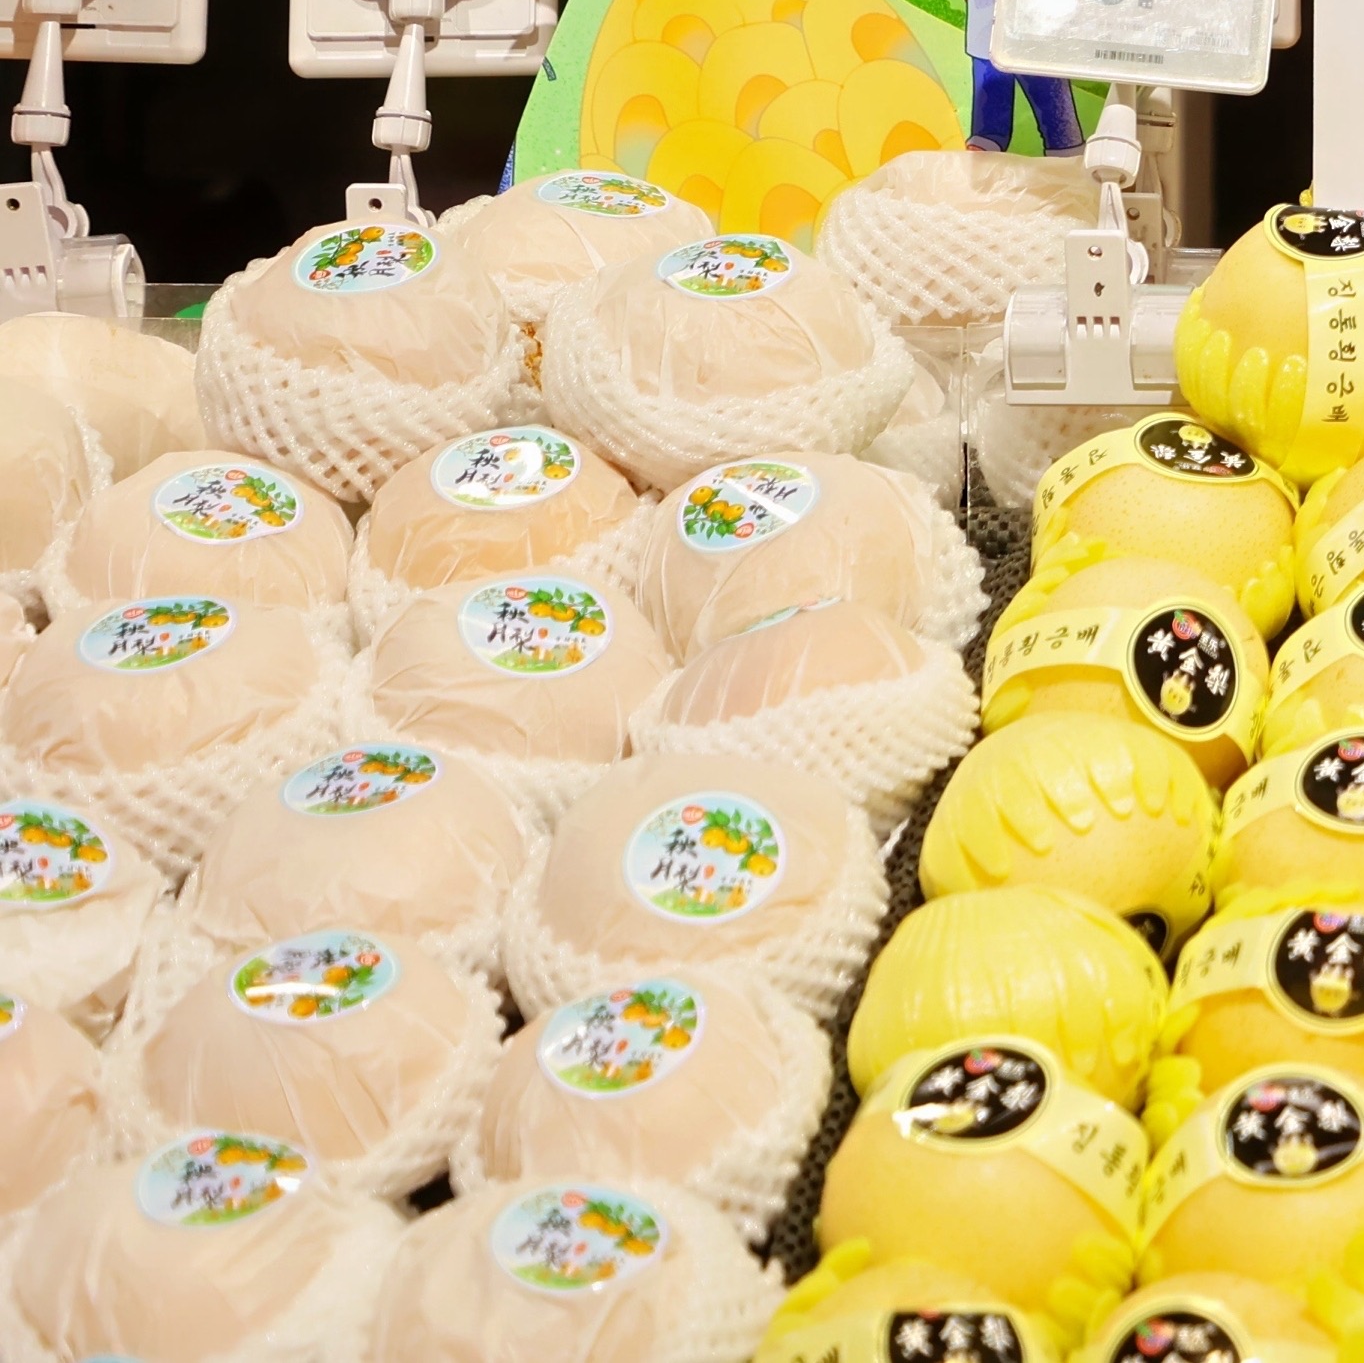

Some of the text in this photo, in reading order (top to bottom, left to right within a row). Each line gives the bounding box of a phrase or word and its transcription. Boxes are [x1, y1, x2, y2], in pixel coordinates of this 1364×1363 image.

[1327, 207, 1363, 252] 金梨
[1149, 442, 1246, 471] 黄金梨
[1147, 627, 1231, 698] 黄金梨
[926, 1064, 1041, 1112] 黄金梨
[1234, 1102, 1349, 1143] 黄金梨
